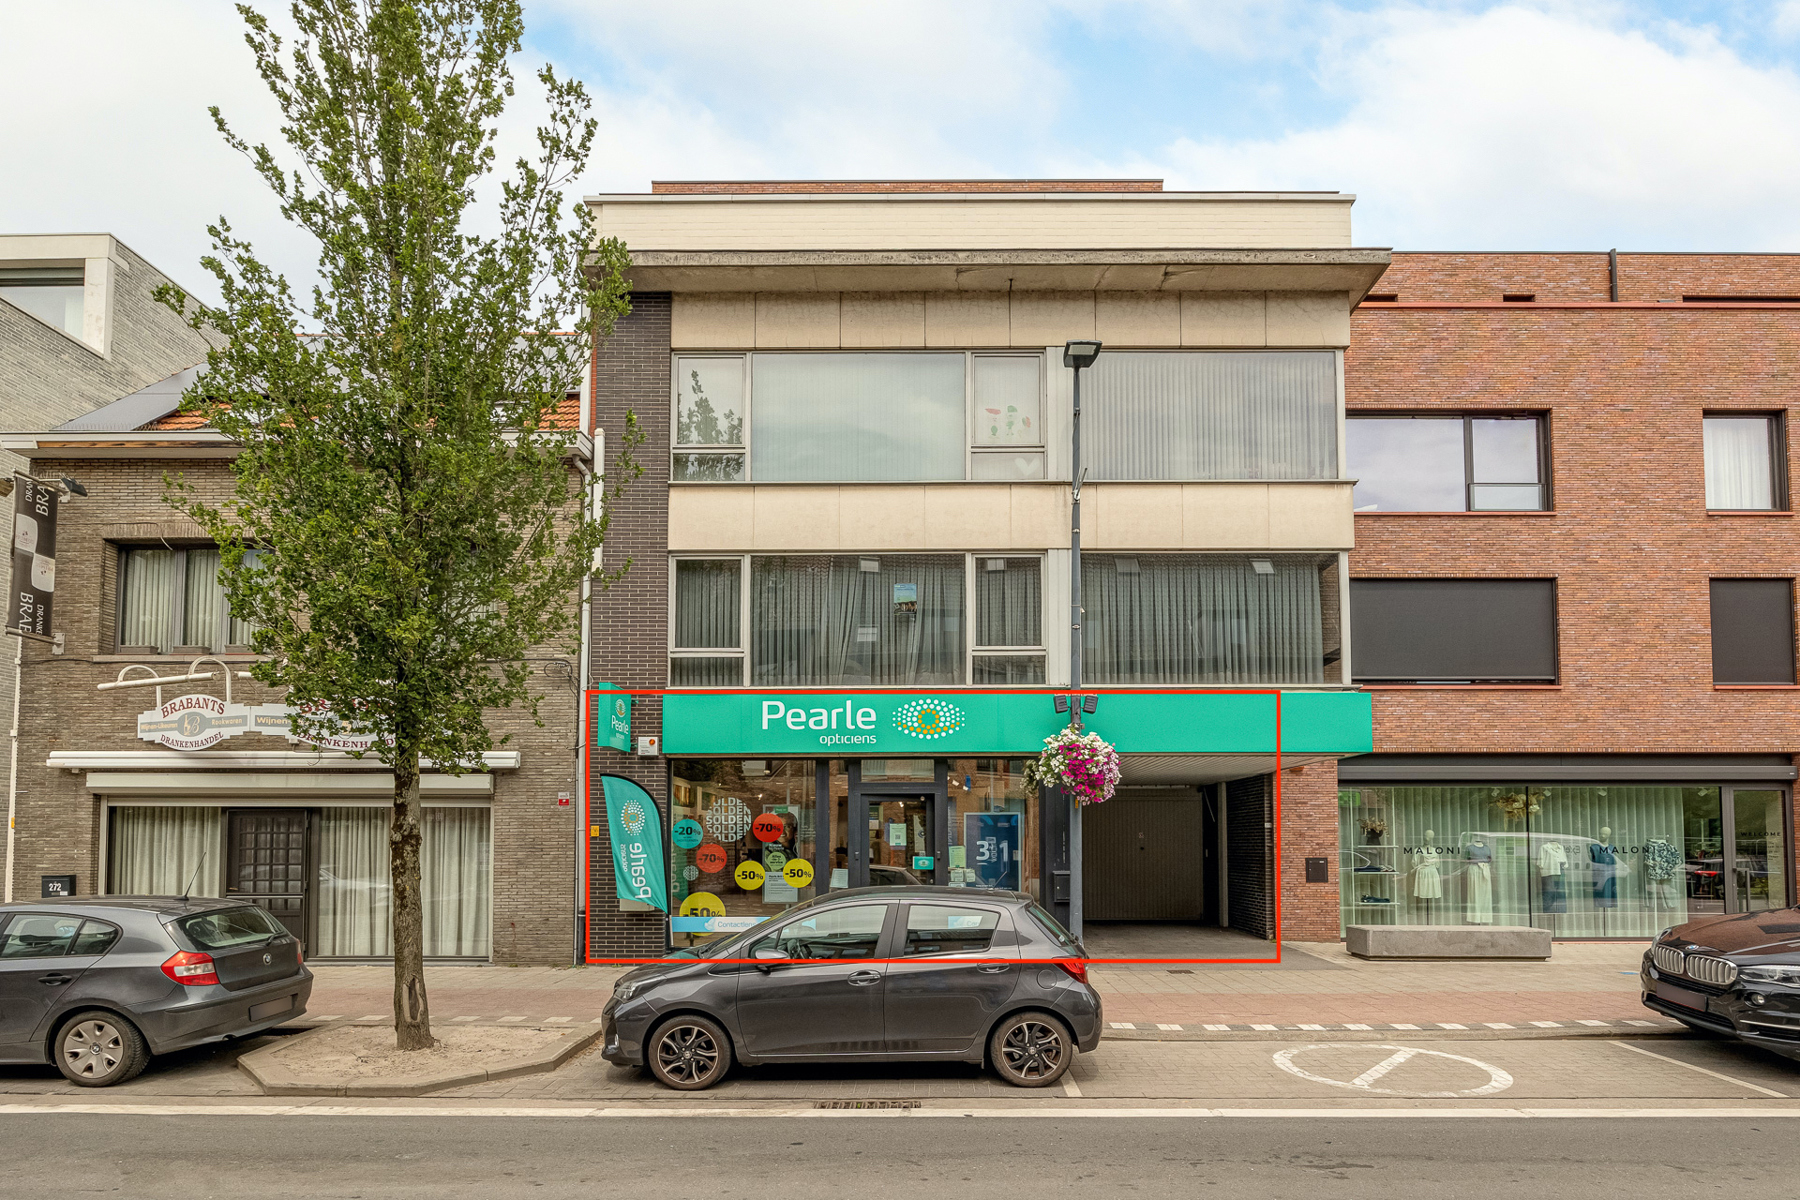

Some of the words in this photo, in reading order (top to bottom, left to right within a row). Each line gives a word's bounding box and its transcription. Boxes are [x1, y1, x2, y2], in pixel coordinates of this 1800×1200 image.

[161, 697, 225, 719] BRABANTS
[762, 700, 877, 730] Pearle
[612, 715, 629, 735] Pearle
[160, 731, 224, 749] DRANKENHANDEL
[819, 733, 877, 747] opticiens
[706, 815, 752, 825] SOLDEN
[674, 826, 701, 836] -20%
[755, 823, 781, 833] -70%
[1403, 846, 1460, 855] MALONI
[1599, 846, 1656, 854] MALONI
[698, 853, 725, 863] -70%
[737, 870, 764, 880] -50%
[785, 868, 812, 878] -50%
[48, 882, 62, 892] 272
